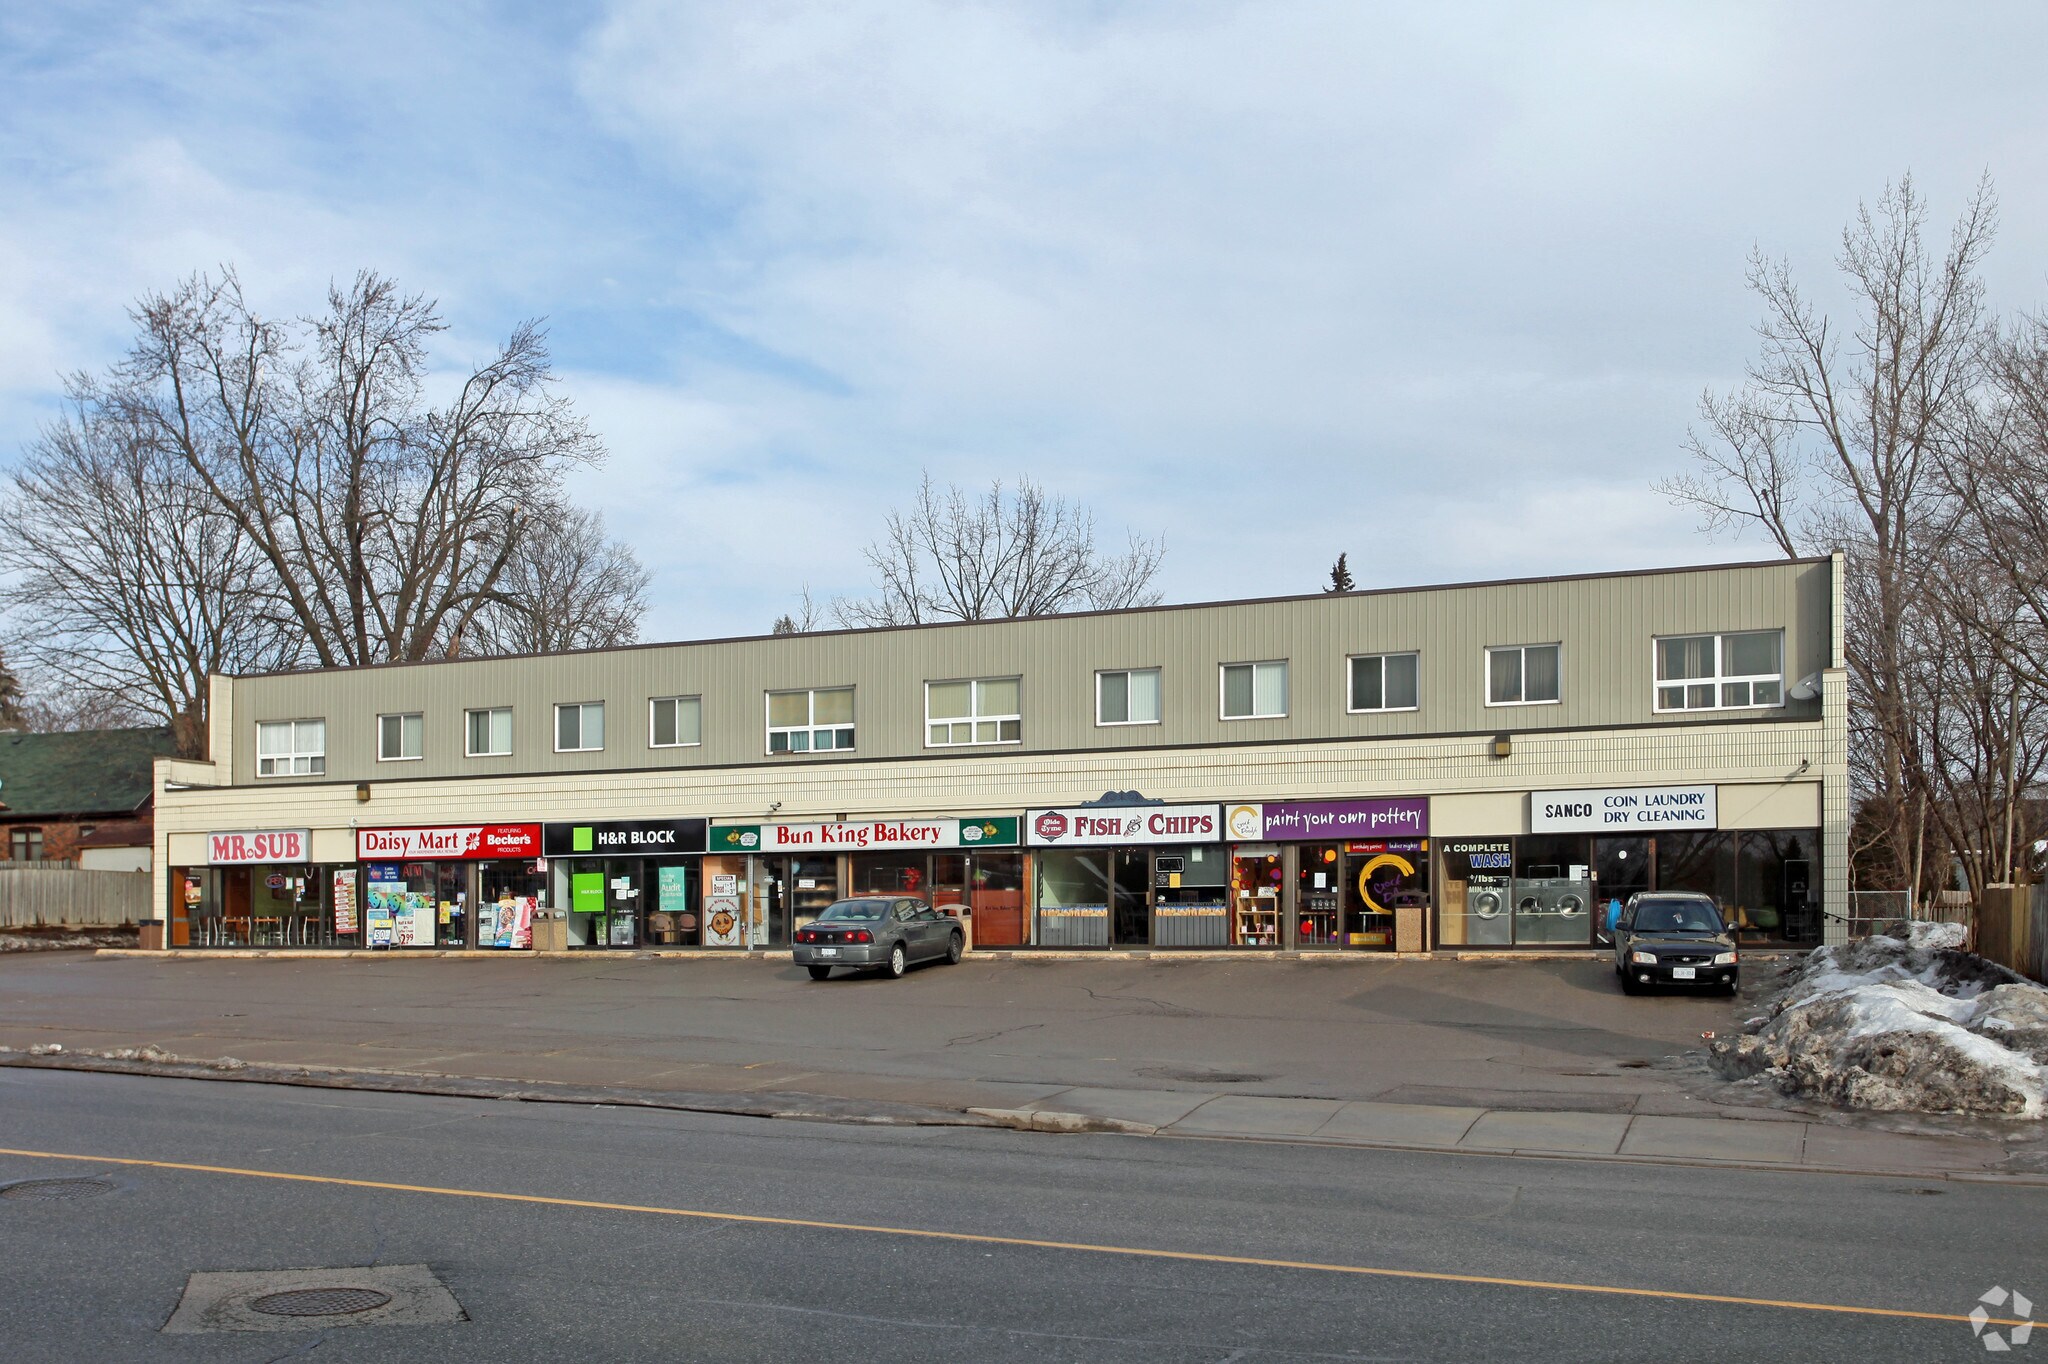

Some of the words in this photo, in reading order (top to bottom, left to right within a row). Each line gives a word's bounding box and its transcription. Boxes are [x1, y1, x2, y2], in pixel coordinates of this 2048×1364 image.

[1604, 796, 1638, 808] COIN
[1645, 793, 1706, 807] LAUNDRY
[1545, 803, 1592, 818] SANCO
[1604, 811, 1629, 823] DRY
[1637, 809, 1706, 822] CLEANING
[1266, 809, 1300, 832] paint
[1304, 812, 1335, 832] your
[1339, 811, 1366, 824] own
[1371, 807, 1421, 829] pottery
[777, 826, 813, 844] Bun
[821, 825, 869, 847] King
[874, 822, 941, 844] Bakery
[1041, 825, 1062, 833] Tyme
[366, 832, 411, 858] Daisy
[418, 831, 458, 849] Mart
[487, 834, 531, 845] Becker's
[598, 832, 627, 845] H&R
[631, 830, 675, 844] BLOCK
[1453, 844, 1509, 852] COMPLETE
[1469, 853, 1511, 868] WASH
[403, 865, 422, 877] ATM
[661, 883, 680, 891] Audit
